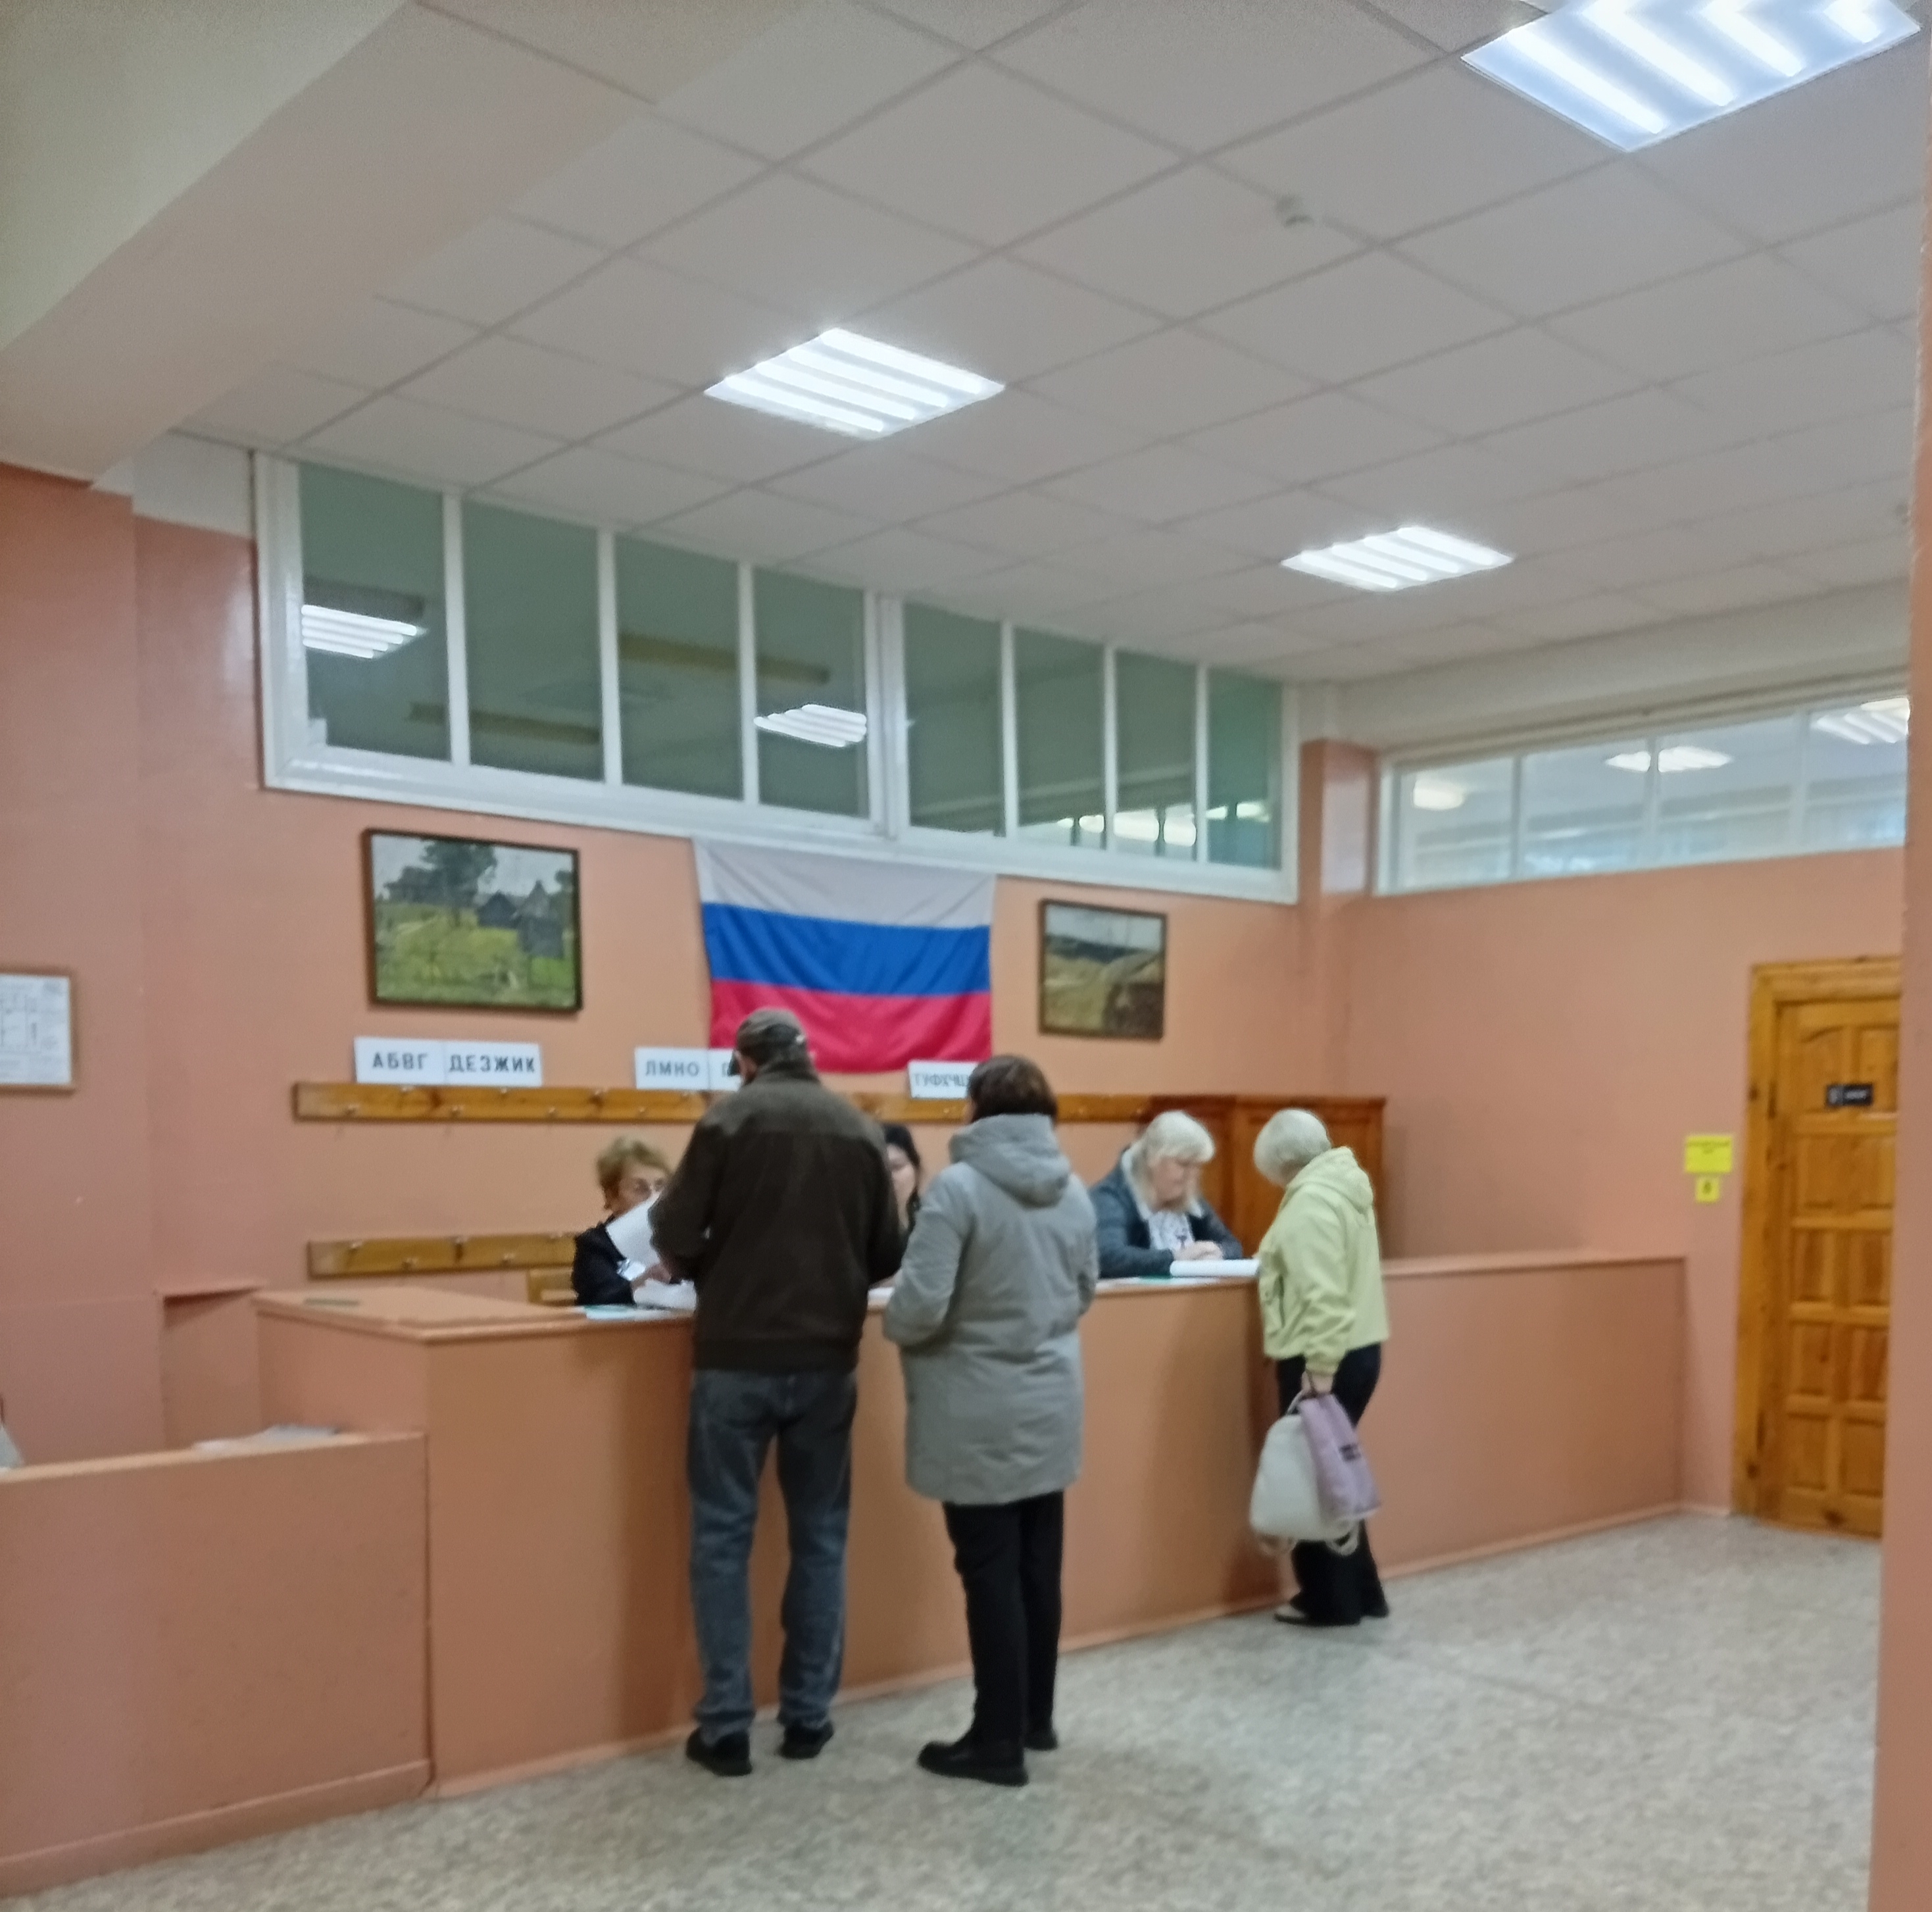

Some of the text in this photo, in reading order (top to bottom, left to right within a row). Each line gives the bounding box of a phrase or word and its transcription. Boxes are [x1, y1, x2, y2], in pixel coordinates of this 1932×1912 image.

[371, 1051, 535, 1073] АБВГ ДЕЗЖИК
[645, 1059, 700, 1077] ЛМНО
